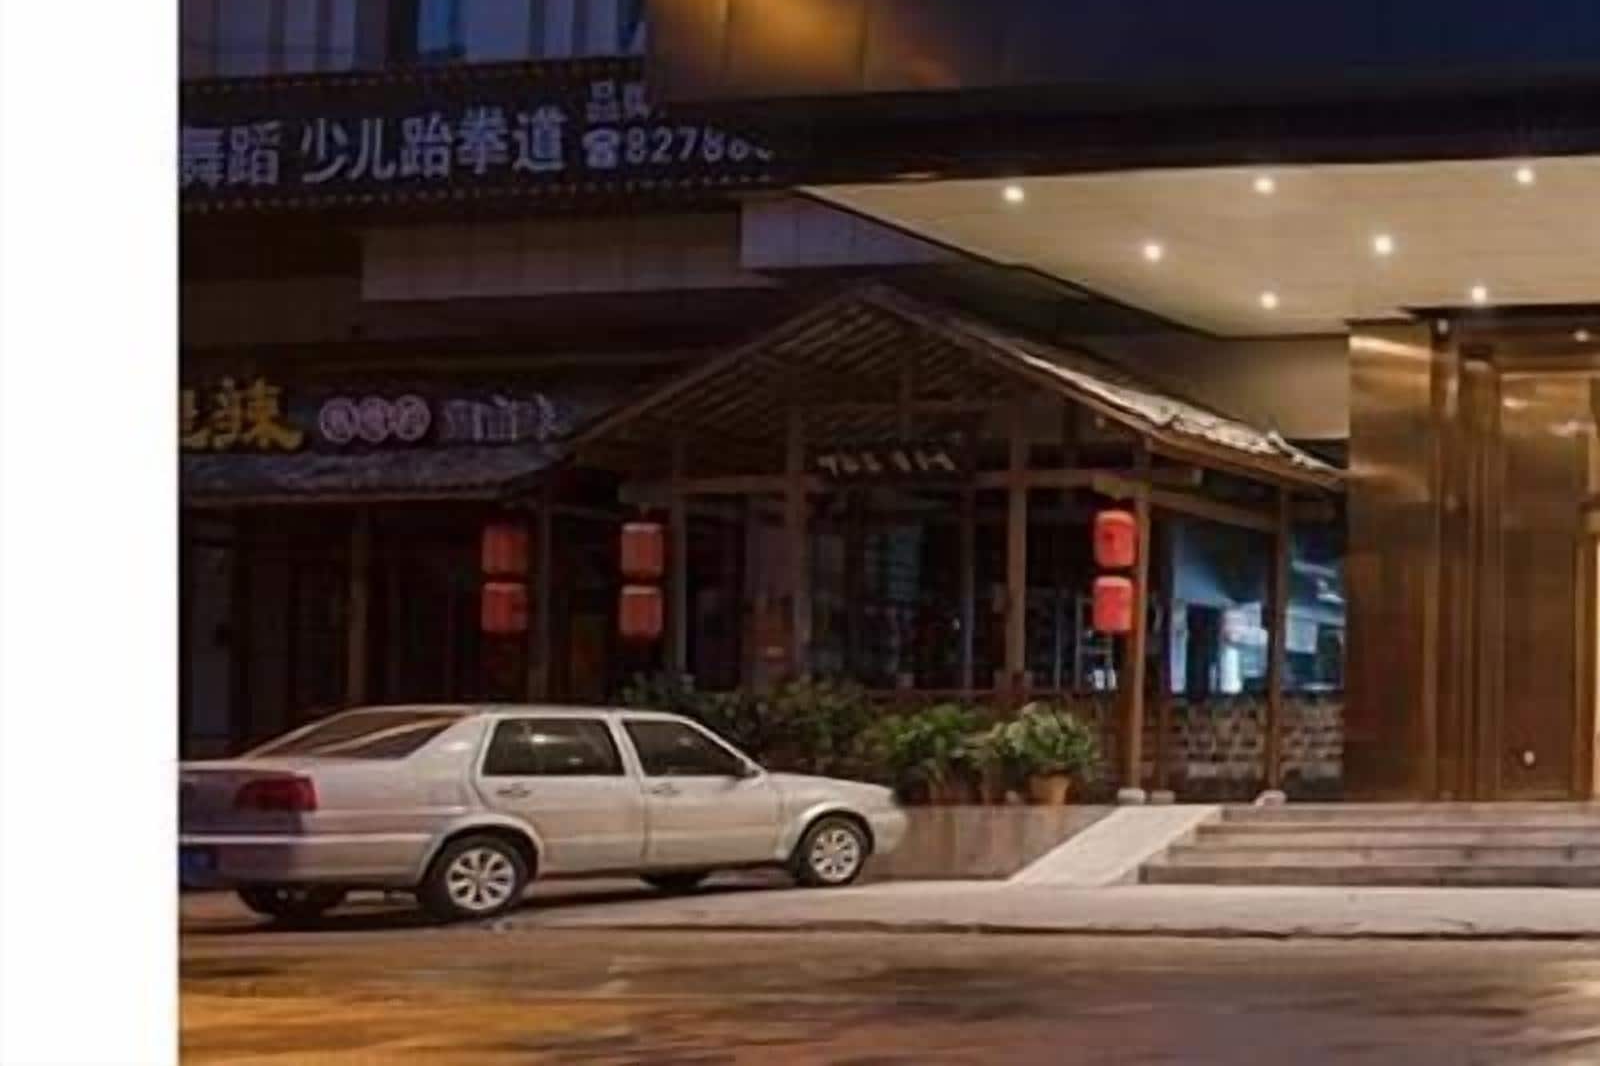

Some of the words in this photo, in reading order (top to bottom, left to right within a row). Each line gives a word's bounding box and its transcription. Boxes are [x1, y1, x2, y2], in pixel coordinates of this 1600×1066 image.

[302, 105, 568, 184] 少儿跆拳道
